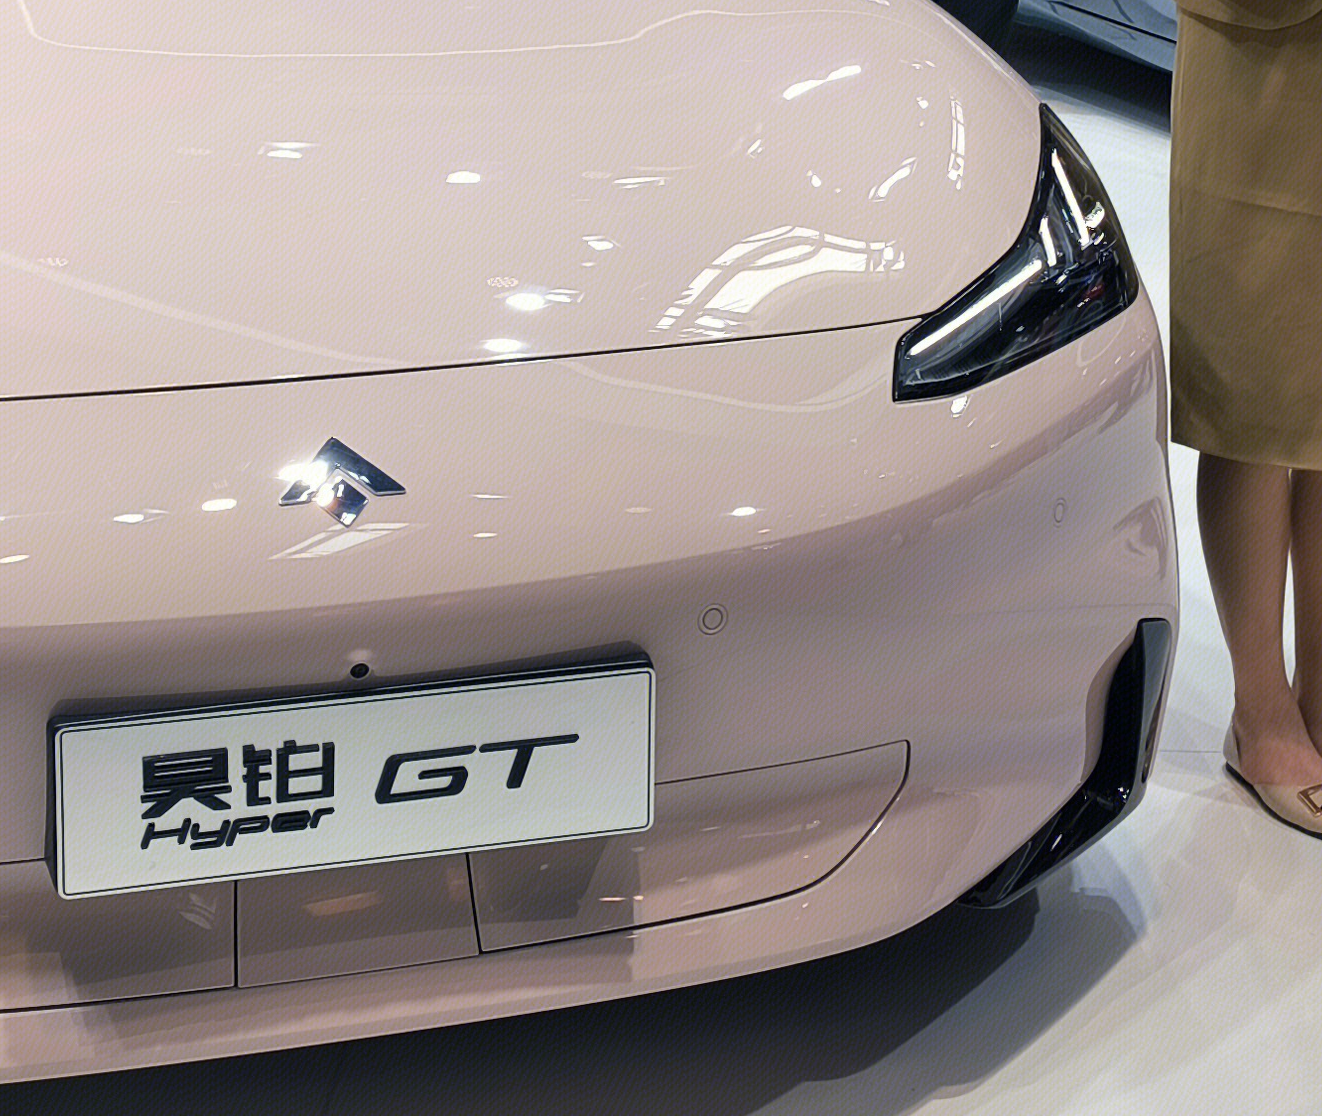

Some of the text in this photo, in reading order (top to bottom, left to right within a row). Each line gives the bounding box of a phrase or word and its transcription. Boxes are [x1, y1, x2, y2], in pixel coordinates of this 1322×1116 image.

[140, 733, 580, 819] 昊铂 GT
[140, 806, 335, 851] Hyper
